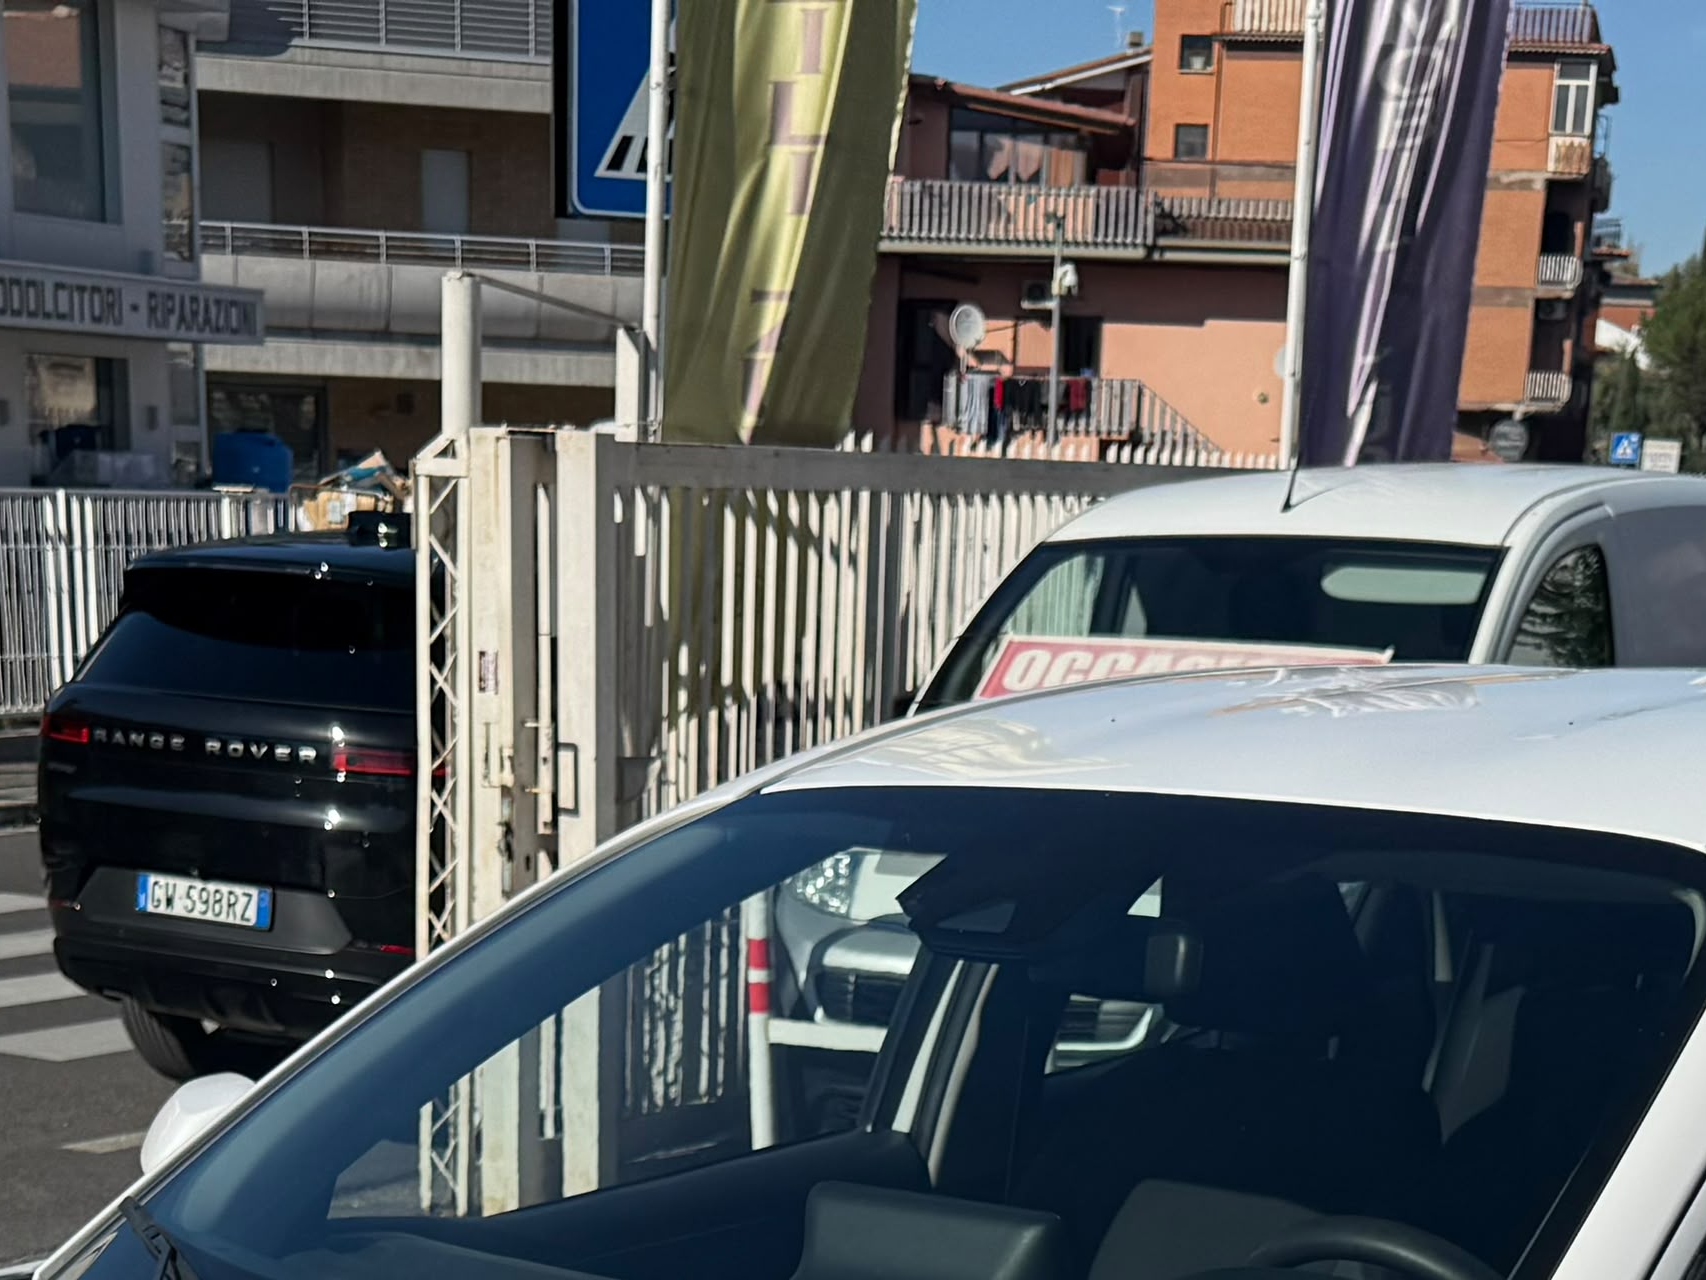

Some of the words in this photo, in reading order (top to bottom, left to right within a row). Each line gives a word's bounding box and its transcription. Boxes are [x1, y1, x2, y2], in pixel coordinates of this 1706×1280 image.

[94, 727, 186, 751] RANGE
[204, 737, 318, 764] ROVER
[151, 880, 177, 910] GW
[183, 885, 253, 922] 598RZ
